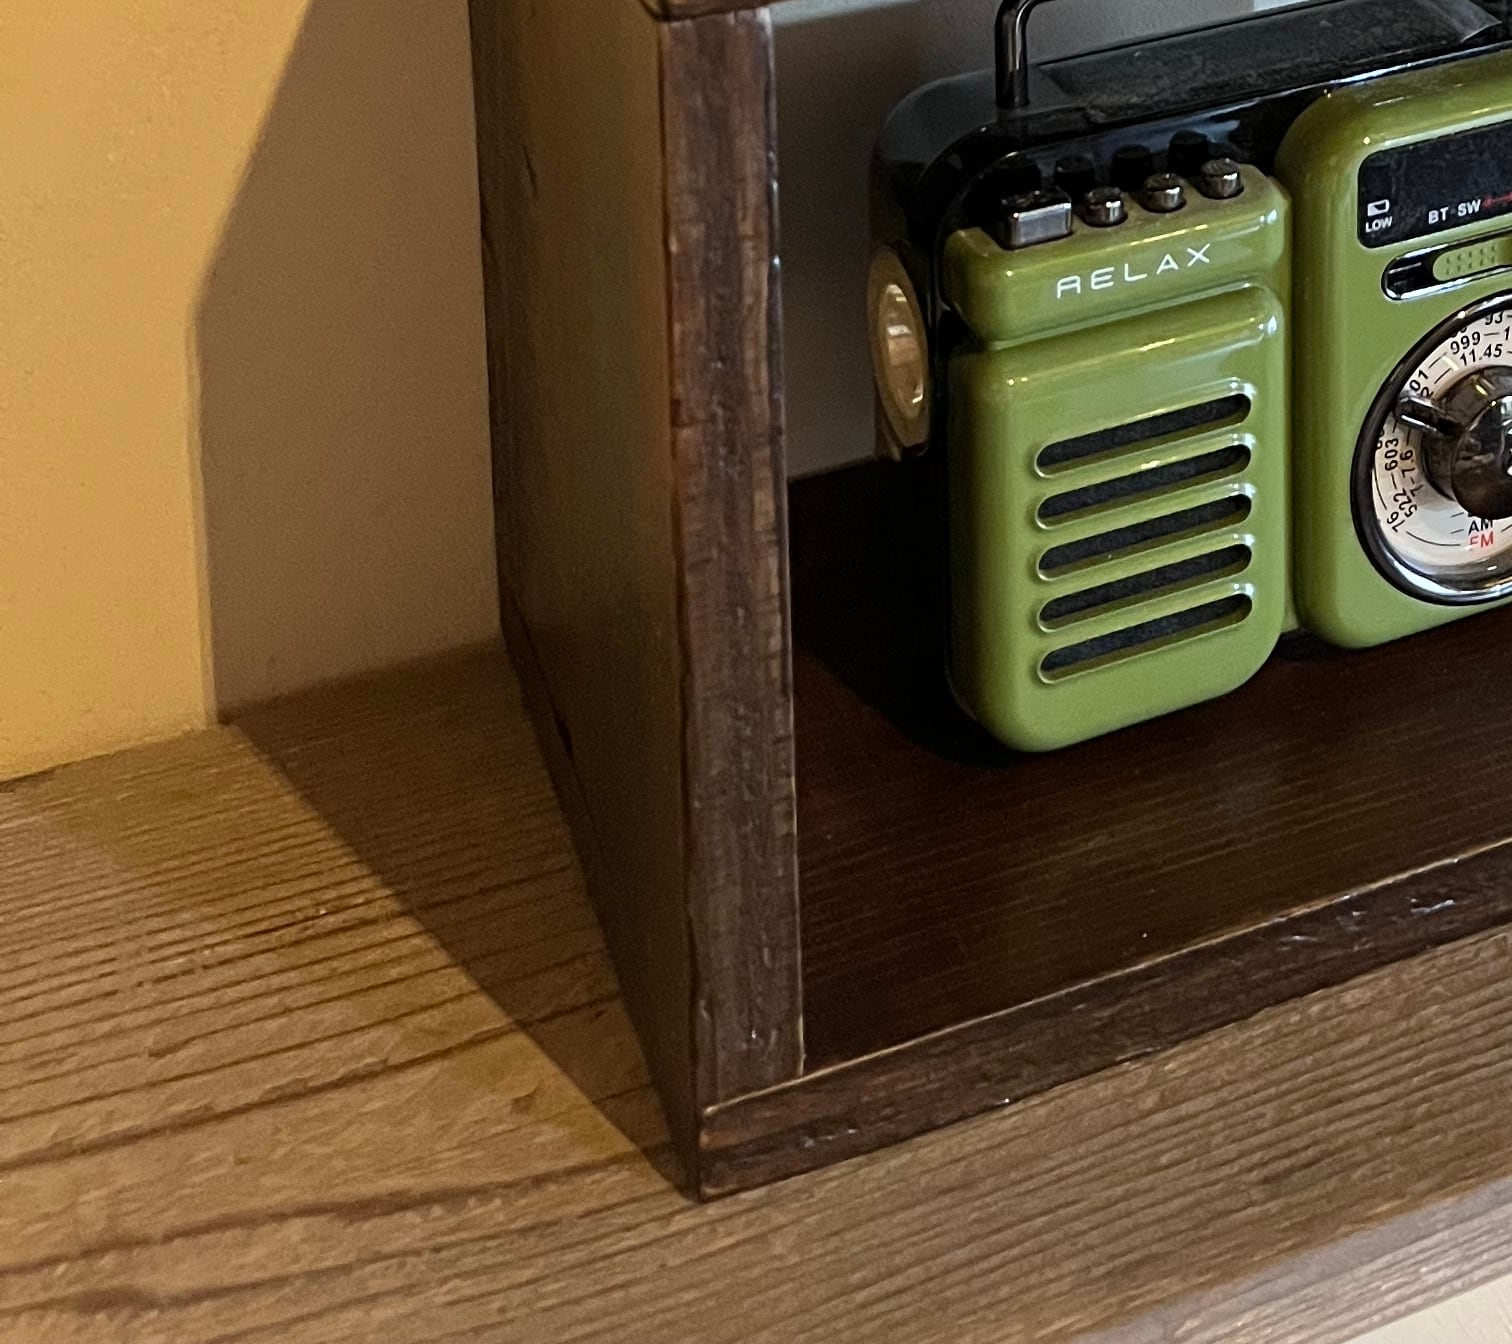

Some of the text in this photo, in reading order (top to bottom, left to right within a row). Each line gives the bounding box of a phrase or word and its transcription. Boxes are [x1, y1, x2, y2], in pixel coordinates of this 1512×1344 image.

[1428, 207, 1449, 226] BT
[1457, 198, 1481, 217] SW
[1365, 216, 1393, 233] LOW
[1056, 242, 1212, 300] RELAX
[1450, 331, 1481, 354] 999
[1460, 343, 1504, 366] 11.45
[1384, 438, 1399, 471] 603
[1393, 488, 1418, 518] 522
[1386, 511, 1405, 533] 76
[1468, 518, 1494, 535] AM
[1469, 532, 1495, 548] FM
